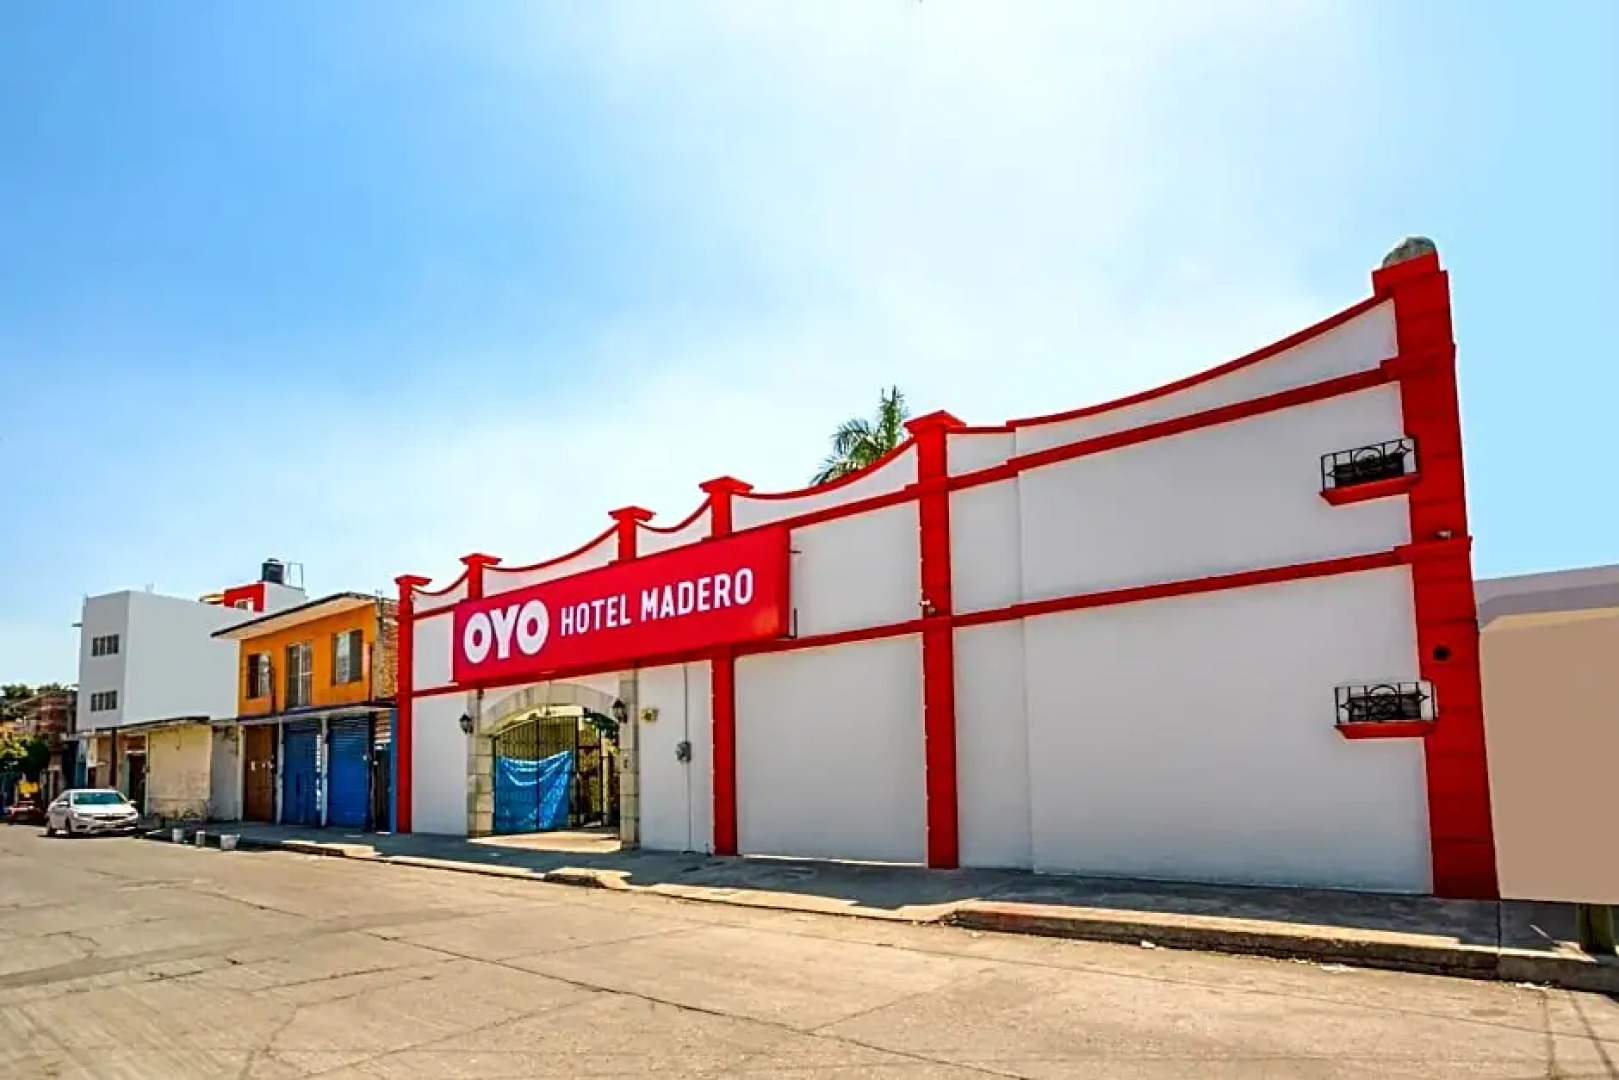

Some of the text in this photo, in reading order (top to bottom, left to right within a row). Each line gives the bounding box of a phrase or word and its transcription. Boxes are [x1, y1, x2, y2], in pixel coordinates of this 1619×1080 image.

[463, 567, 754, 664] OYO HOTEL MADERO
